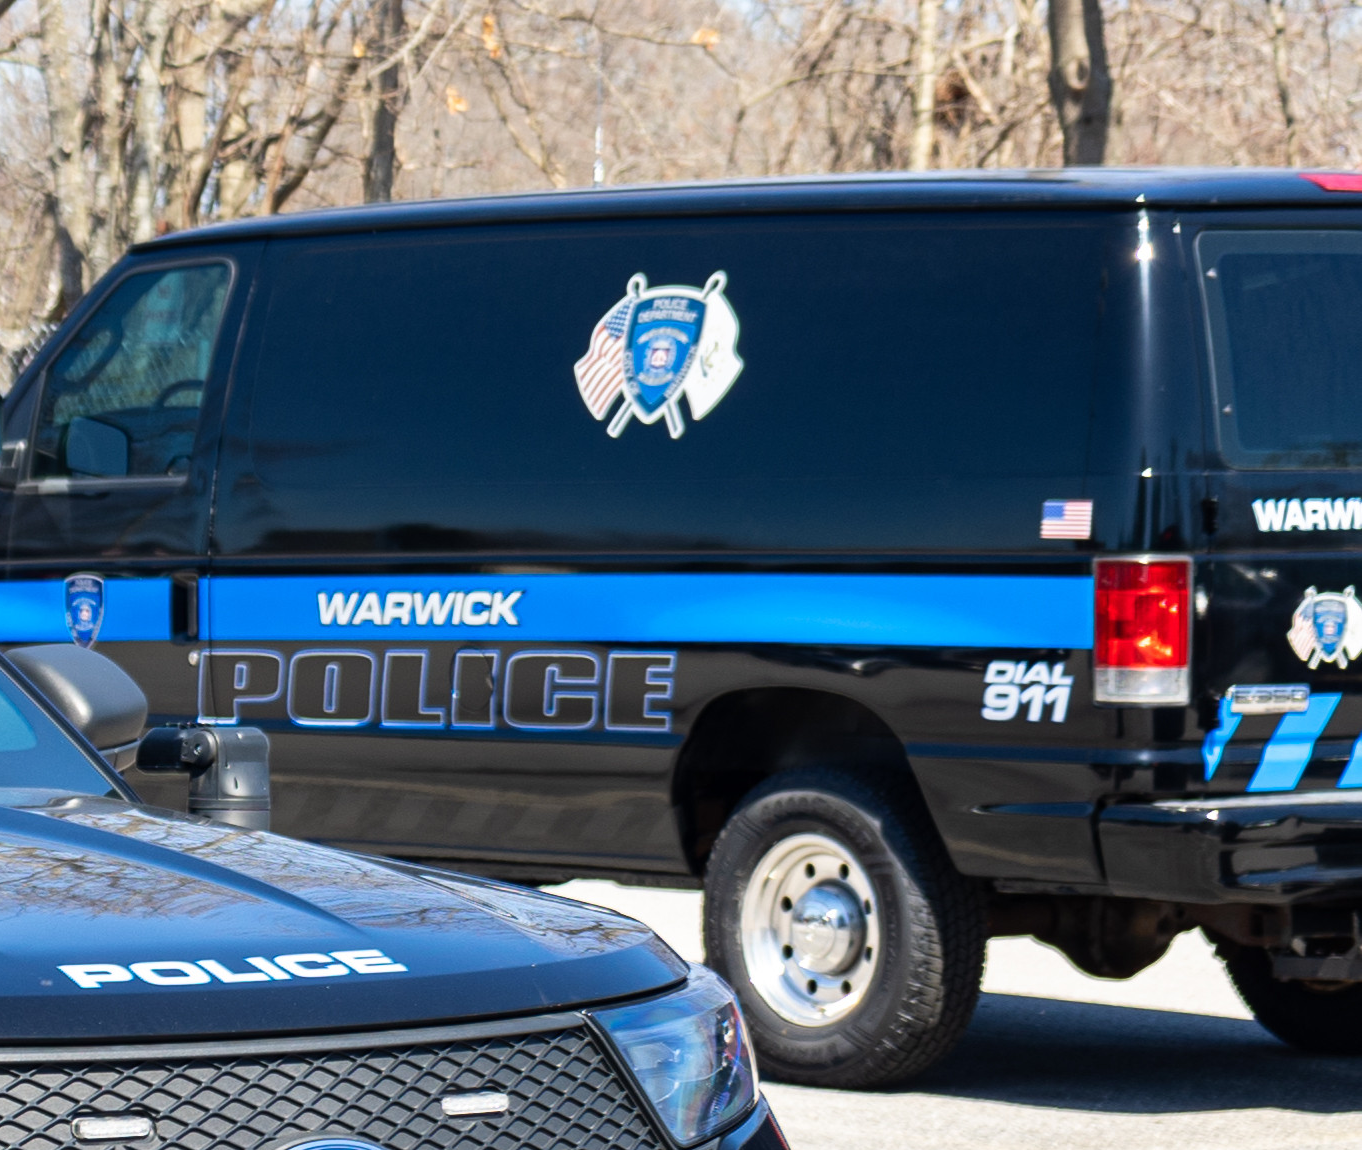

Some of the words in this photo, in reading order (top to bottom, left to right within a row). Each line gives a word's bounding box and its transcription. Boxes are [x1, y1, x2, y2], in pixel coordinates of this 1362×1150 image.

[1252, 498, 1362, 531] WARWI
[316, 590, 523, 626] WARWICK
[196, 648, 676, 732] POLICE
[983, 660, 1074, 685] DIAL
[981, 684, 1071, 723] 911
[56, 949, 409, 989] POLICE
